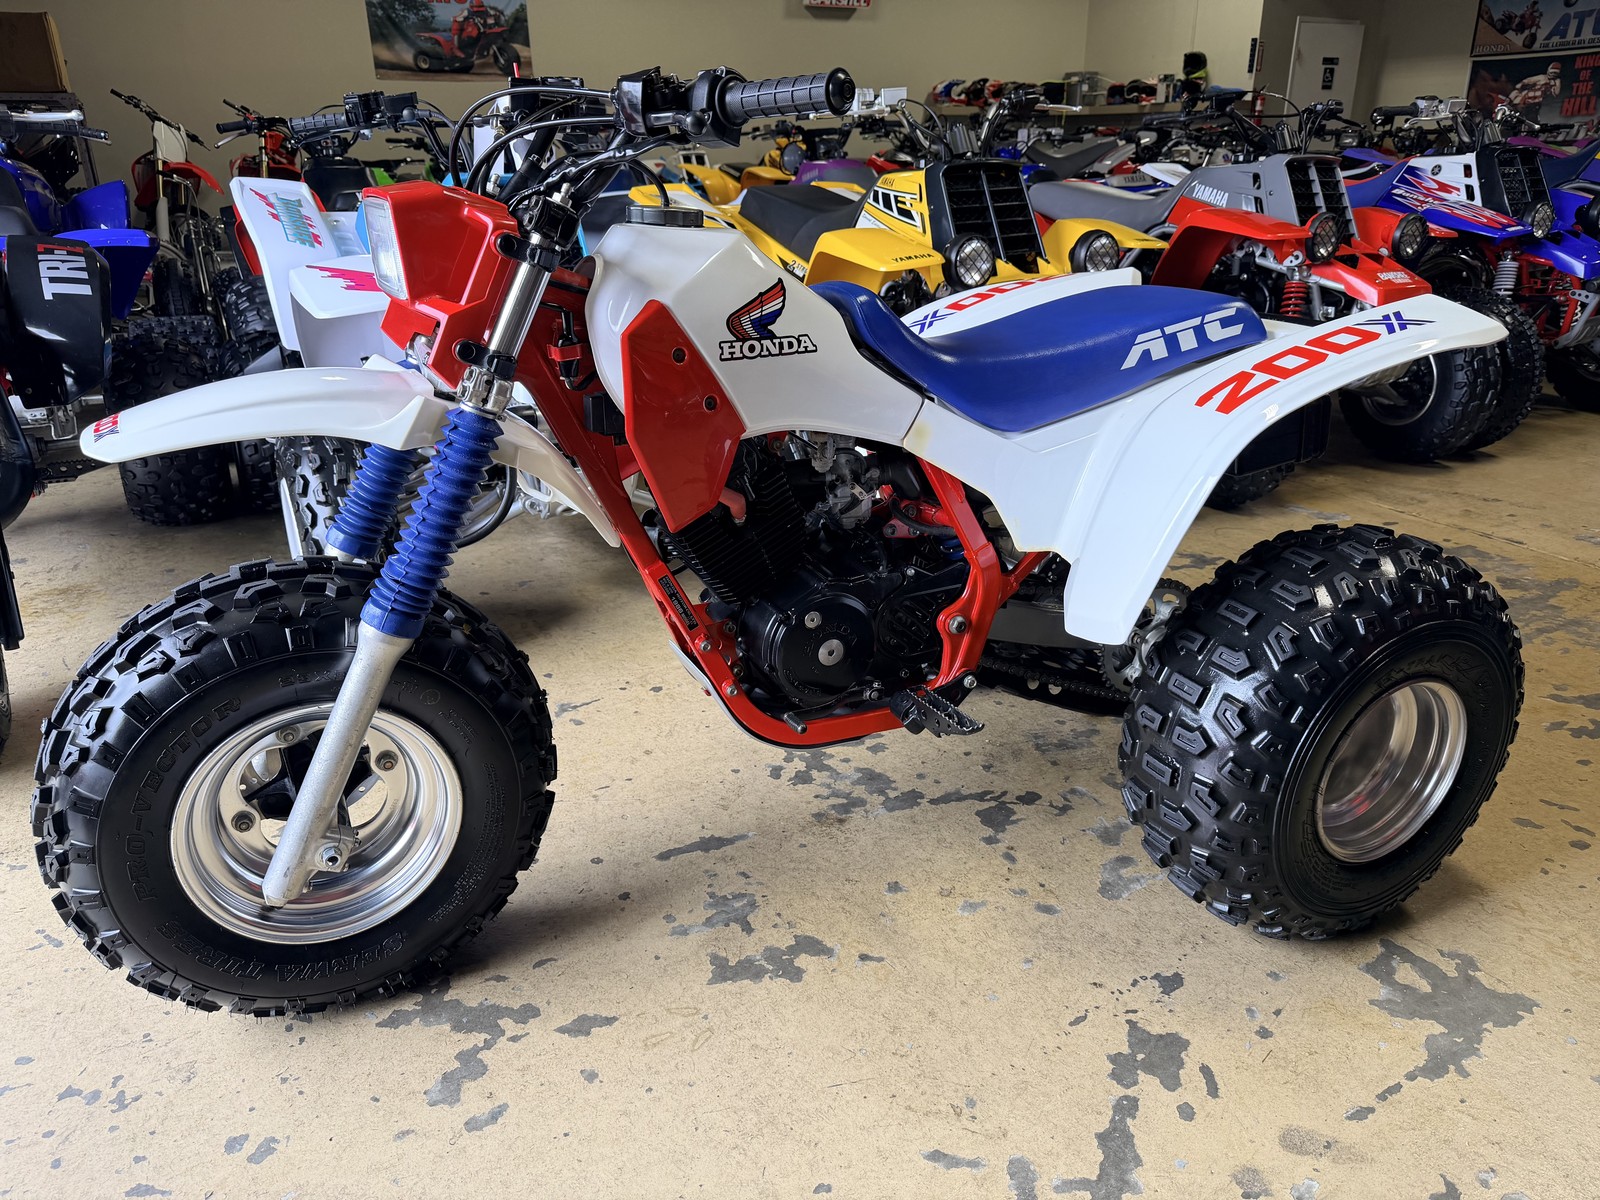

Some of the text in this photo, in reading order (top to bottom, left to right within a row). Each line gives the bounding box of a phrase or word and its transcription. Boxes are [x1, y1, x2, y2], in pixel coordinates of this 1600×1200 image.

[1475, 44, 1512, 53] HONDA
[1572, 82, 1594, 95] THE
[1561, 96, 1597, 117] HILL
[1192, 183, 1229, 208] YAMAHA
[891, 253, 934, 263] YAMAHA
[719, 334, 818, 361] HONDA
[1120, 307, 1245, 371] ATC
[1194, 310, 1437, 415] 200X
[125, 697, 242, 902] PRO-VECTOR
[155, 920, 267, 981] TIRES
